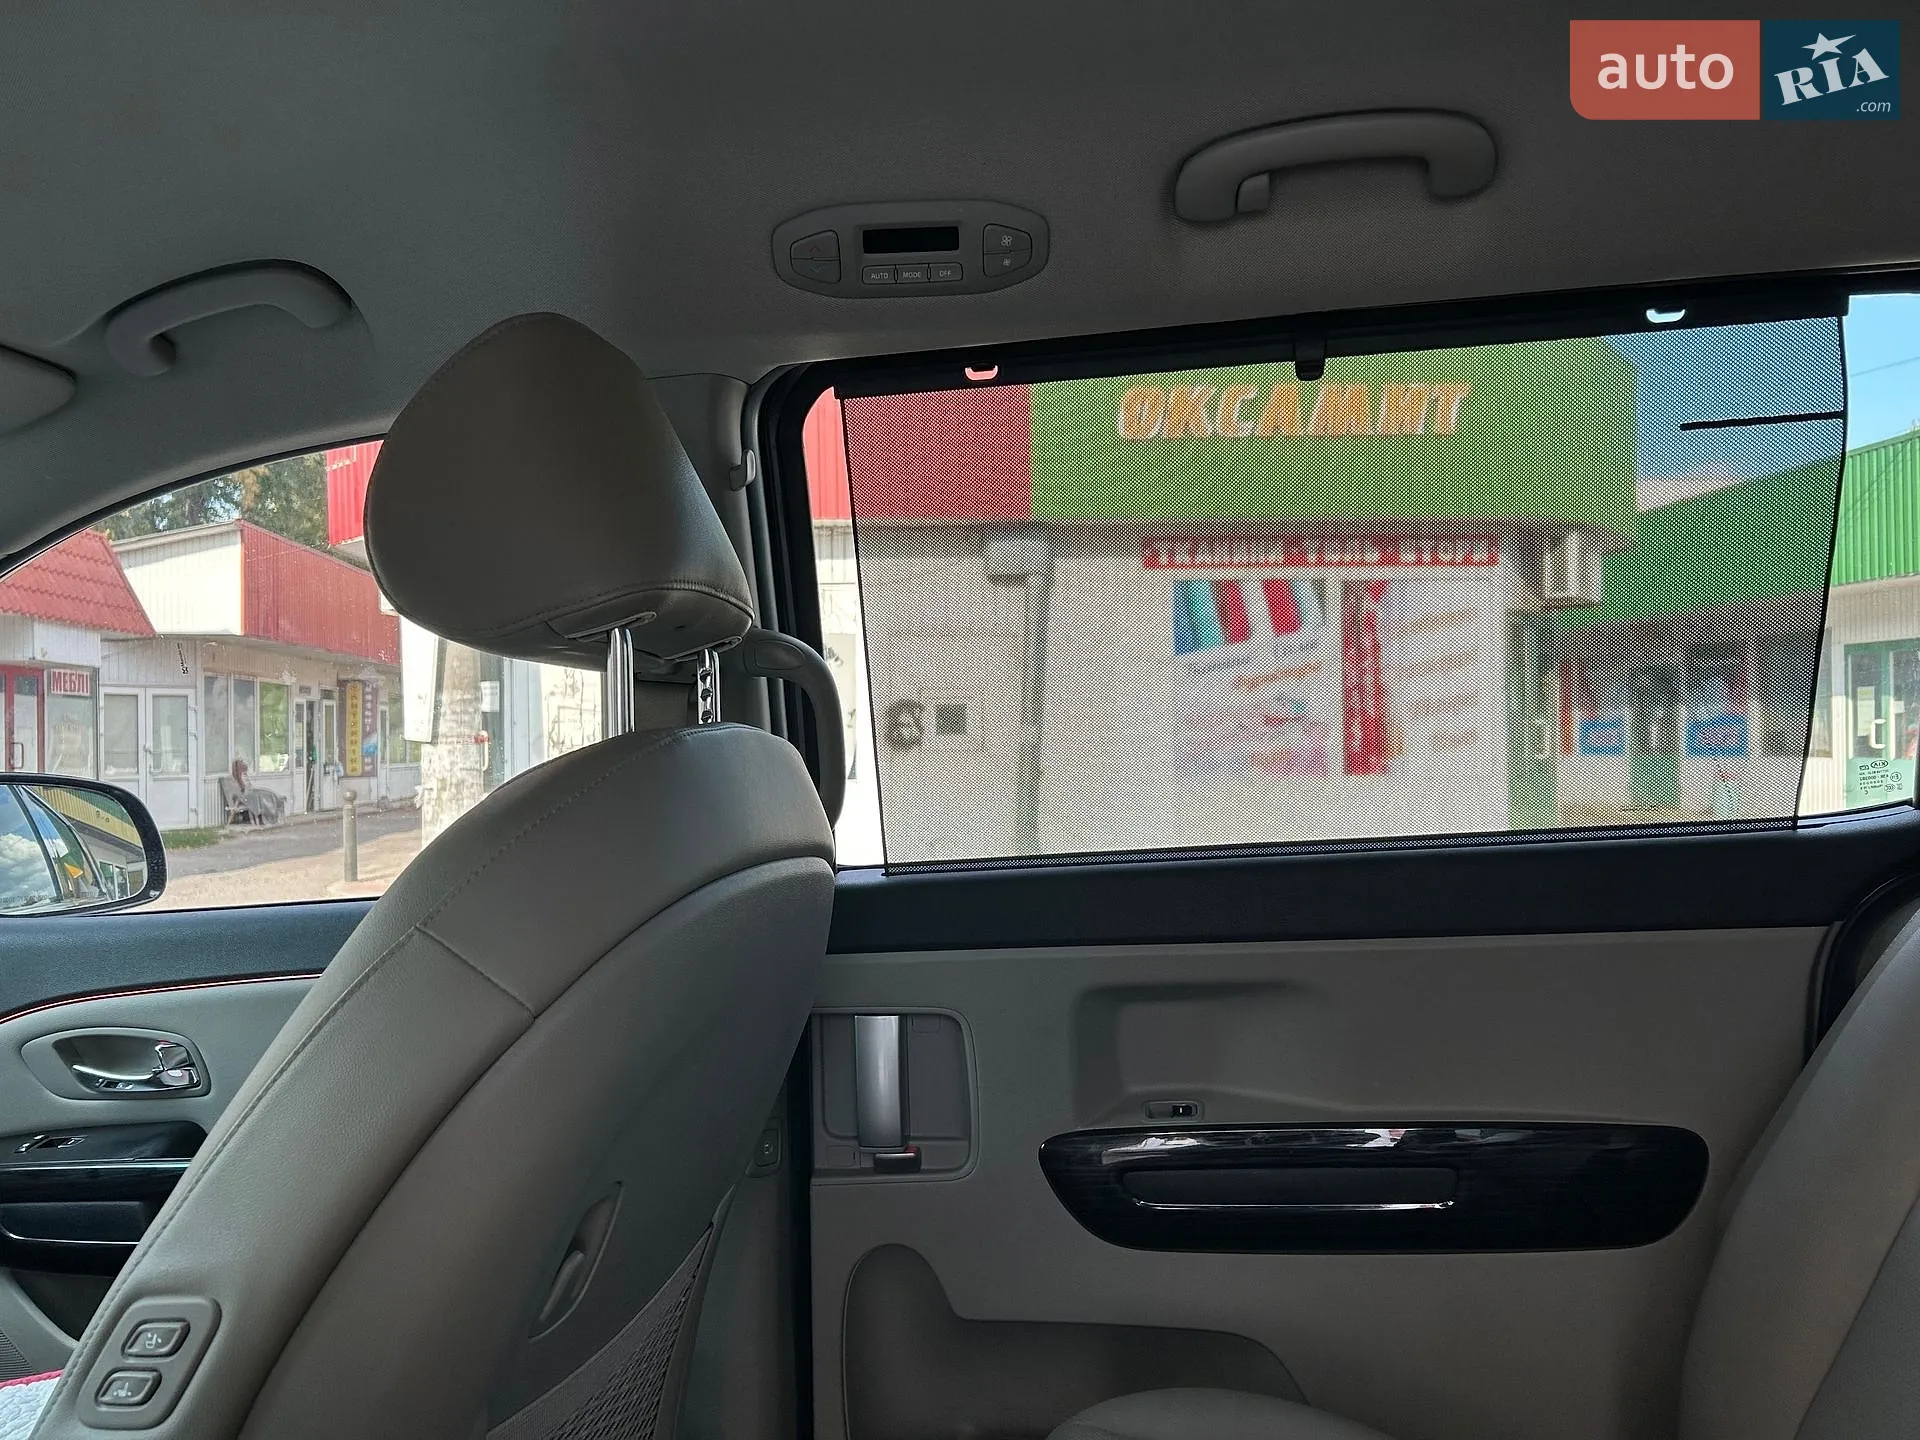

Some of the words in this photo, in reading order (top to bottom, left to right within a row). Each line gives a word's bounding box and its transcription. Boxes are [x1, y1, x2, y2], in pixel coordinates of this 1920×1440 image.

[870, 272, 889, 280] AUTO
[902, 271, 921, 279] MODE
[1118, 383, 1471, 440] ОКСАМИТ
[52, 671, 89, 694] МЕБЛІ
